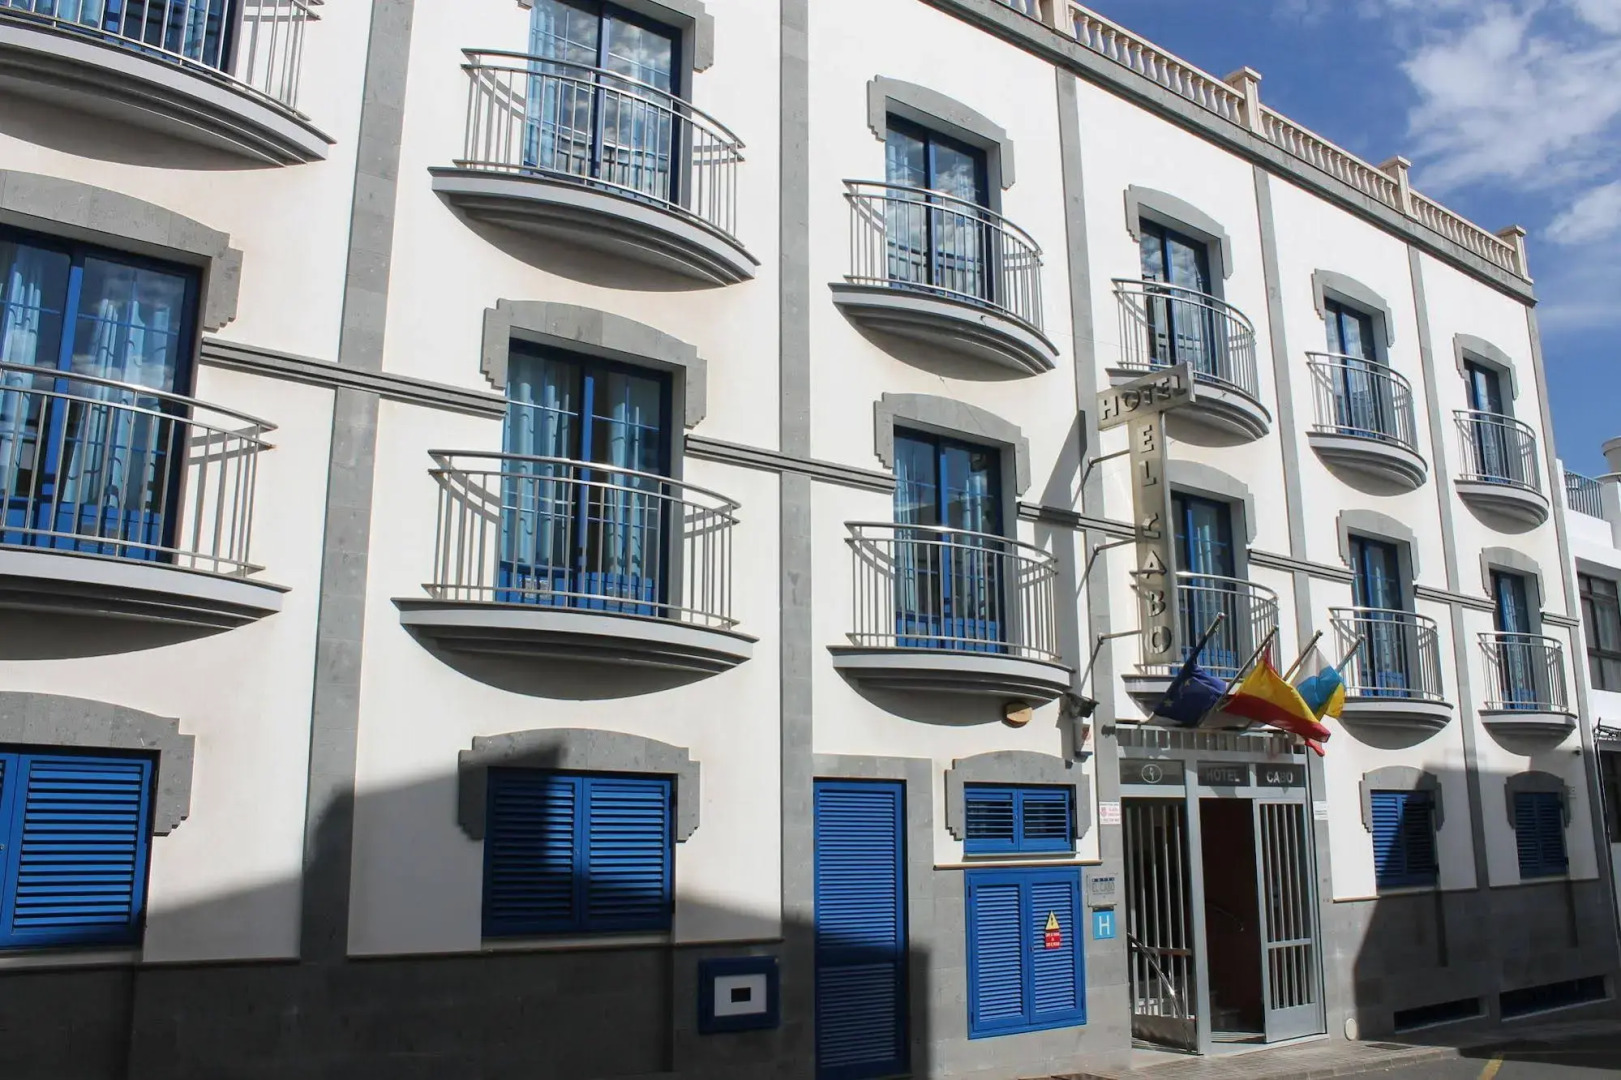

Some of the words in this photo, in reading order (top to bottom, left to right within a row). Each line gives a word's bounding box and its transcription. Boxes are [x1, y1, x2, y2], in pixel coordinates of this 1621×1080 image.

[1101, 374, 1187, 420] HOTEL
[1137, 425, 1158, 488] EL
[1206, 768, 1240, 782] HOTEL
[1266, 771, 1294, 784] CABO
[1098, 914, 1111, 936] H
